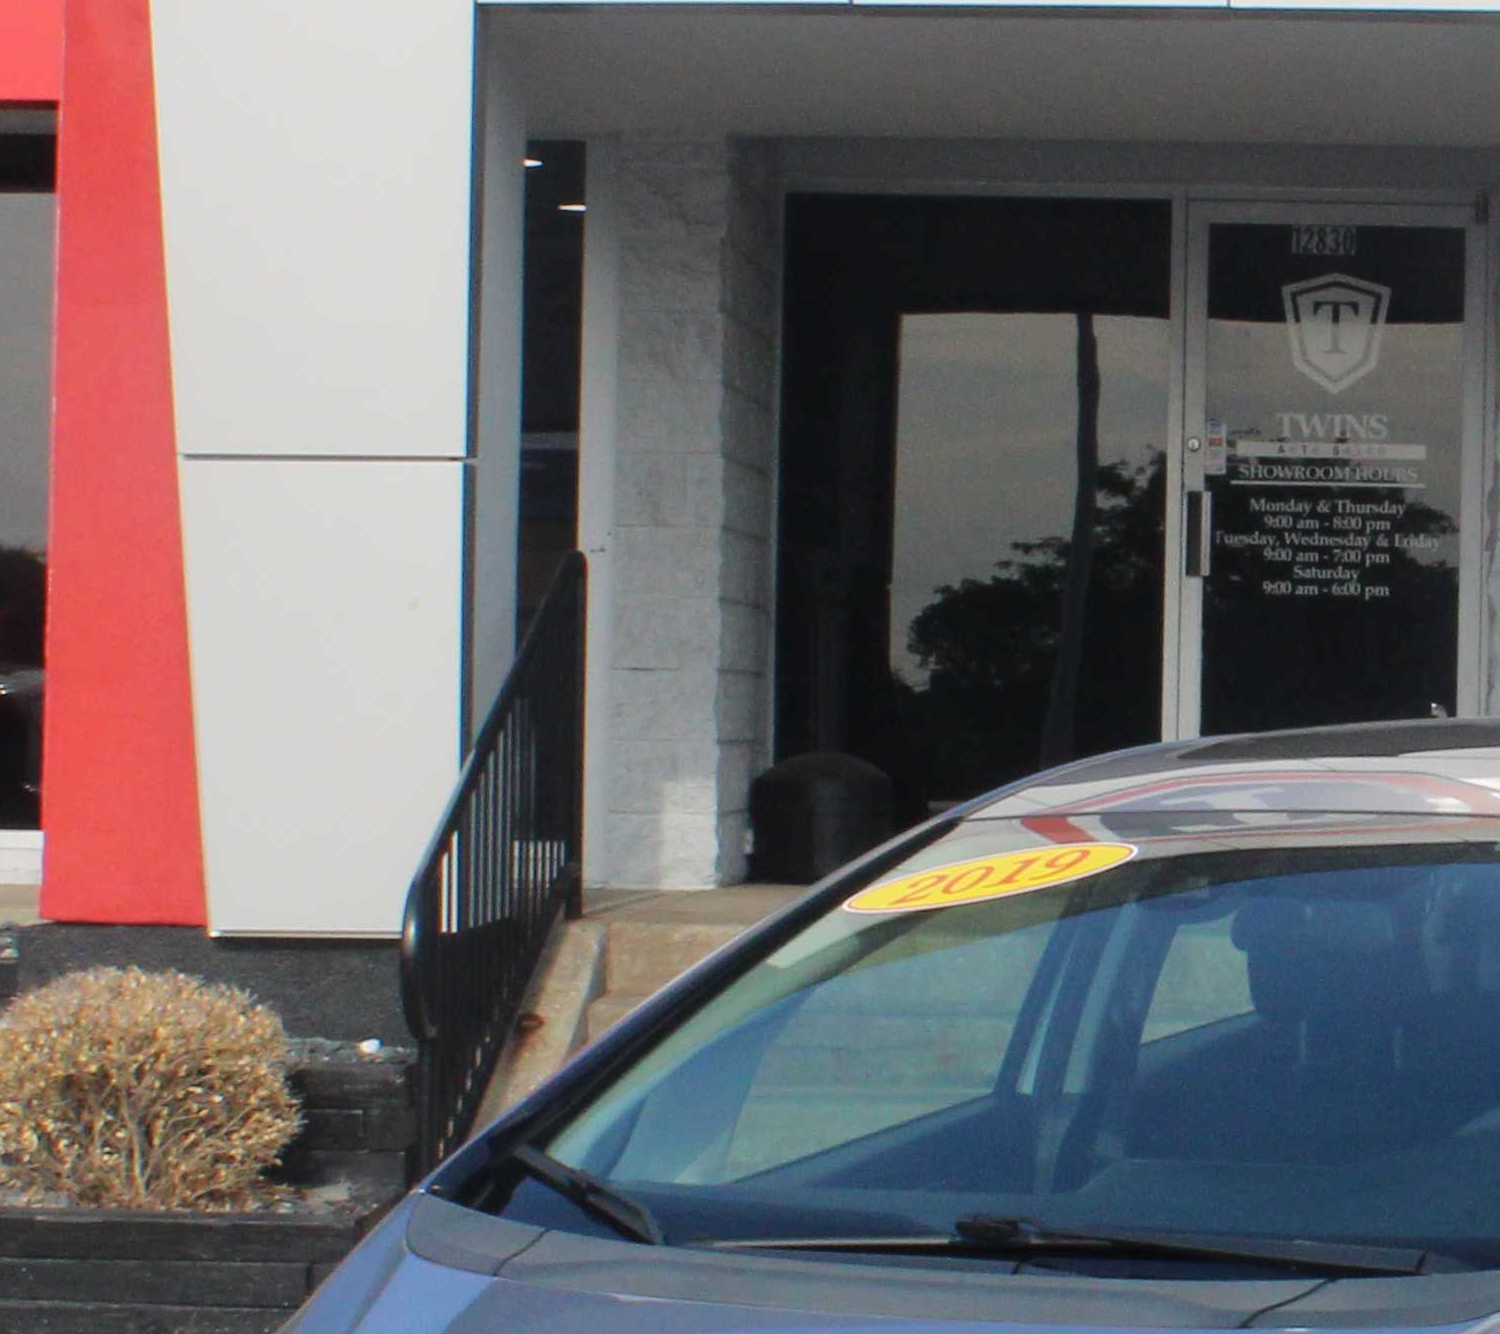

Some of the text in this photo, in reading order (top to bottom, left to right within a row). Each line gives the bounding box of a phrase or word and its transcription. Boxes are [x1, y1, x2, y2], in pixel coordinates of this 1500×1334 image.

[1312, 300, 1359, 355] T
[1276, 412, 1389, 440] TWINS
[1239, 465, 1418, 483] SHOWROOM HOURS
[1250, 498, 1406, 517] Monday & Thursday
[1263, 515, 1293, 529] 9:00
[1296, 519, 1319, 529] am
[1333, 516, 1362, 530] 8:00
[1366, 520, 1391, 534] pm
[1215, 532, 1440, 550] Tuesday, Wednesday & Friday
[1263, 548, 1292, 562] 9:00
[1296, 552, 1319, 562] am
[1333, 549, 1361, 563] 7:00
[1365, 553, 1390, 567] pm
[1293, 565, 1360, 581] Saturday
[1262, 581, 1292, 595] 9:00
[1295, 585, 1319, 595] am
[1332, 582, 1361, 596] 6:00
[1365, 586, 1390, 600] pm
[888, 848, 1090, 907] 2019
